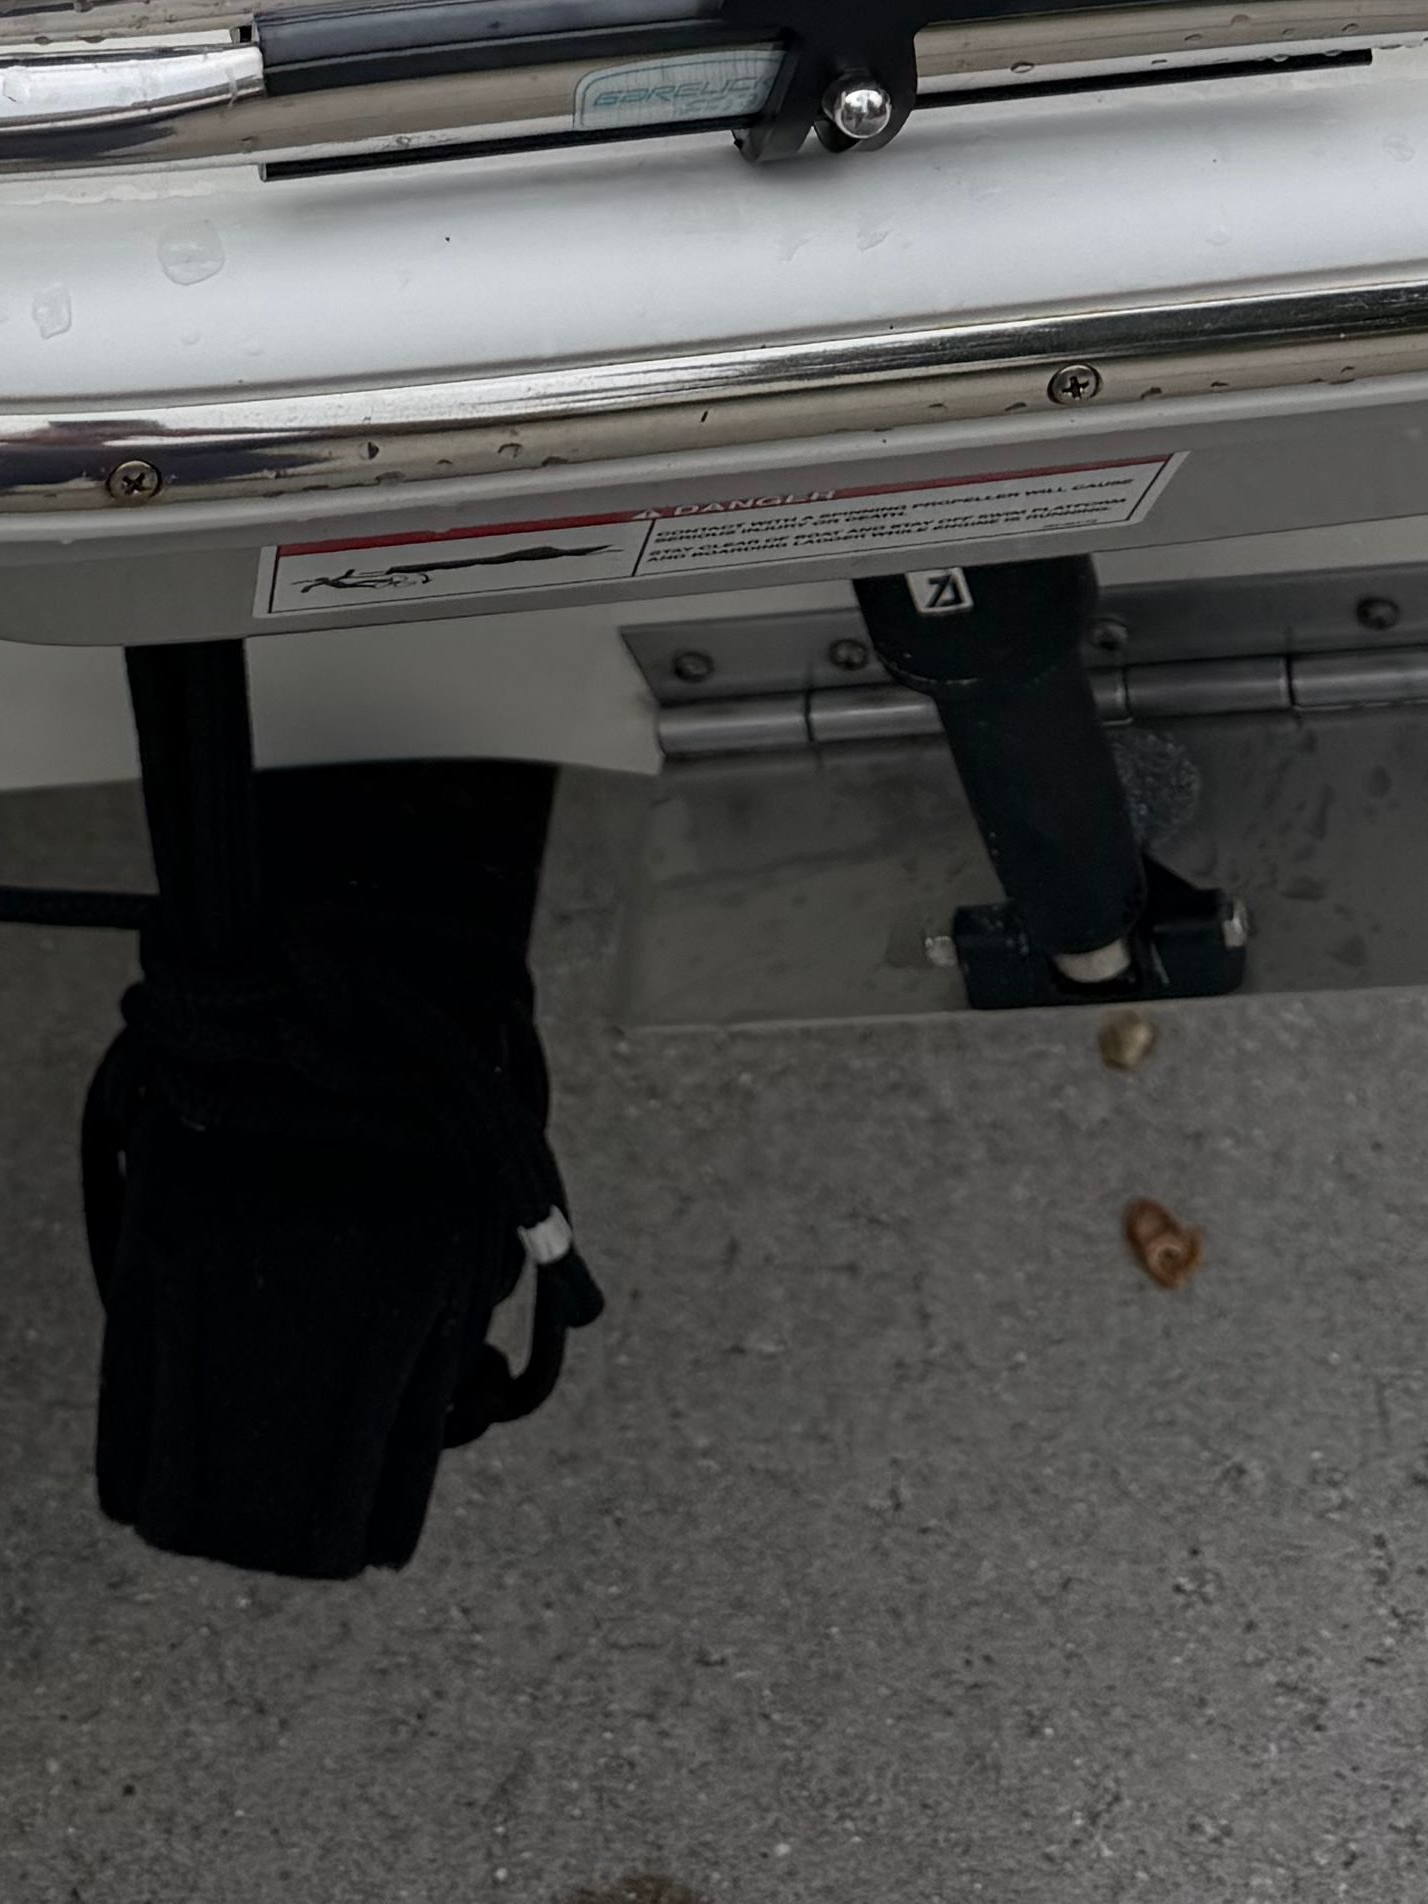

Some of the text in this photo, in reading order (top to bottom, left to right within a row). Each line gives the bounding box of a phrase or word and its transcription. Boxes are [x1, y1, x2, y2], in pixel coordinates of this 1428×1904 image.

[649, 547, 693, 555] STAY
[699, 539, 759, 550] CLEAR
[795, 530, 844, 540] BOAT
[847, 525, 885, 534] AND
[891, 520, 933, 529] STAY
[938, 515, 973, 524] OFF
[978, 509, 1026, 519] SWIM
[1032, 498, 1126, 513] PLATFORM
[657, 522, 746, 536] CONTACT
[751, 517, 797, 526] WITH
[820, 504, 907, 518] SPINNING
[912, 492, 1019, 509] PROPELLER
[1025, 487, 1066, 496] WILL
[1072, 478, 1134, 491] CAUSE
[648, 554, 685, 563] AND
[691, 542, 788, 557] BOARDING
[793, 533, 865, 545] LADDER
[872, 526, 927, 537] WHILE
[932, 519, 999, 531] ENGINE
